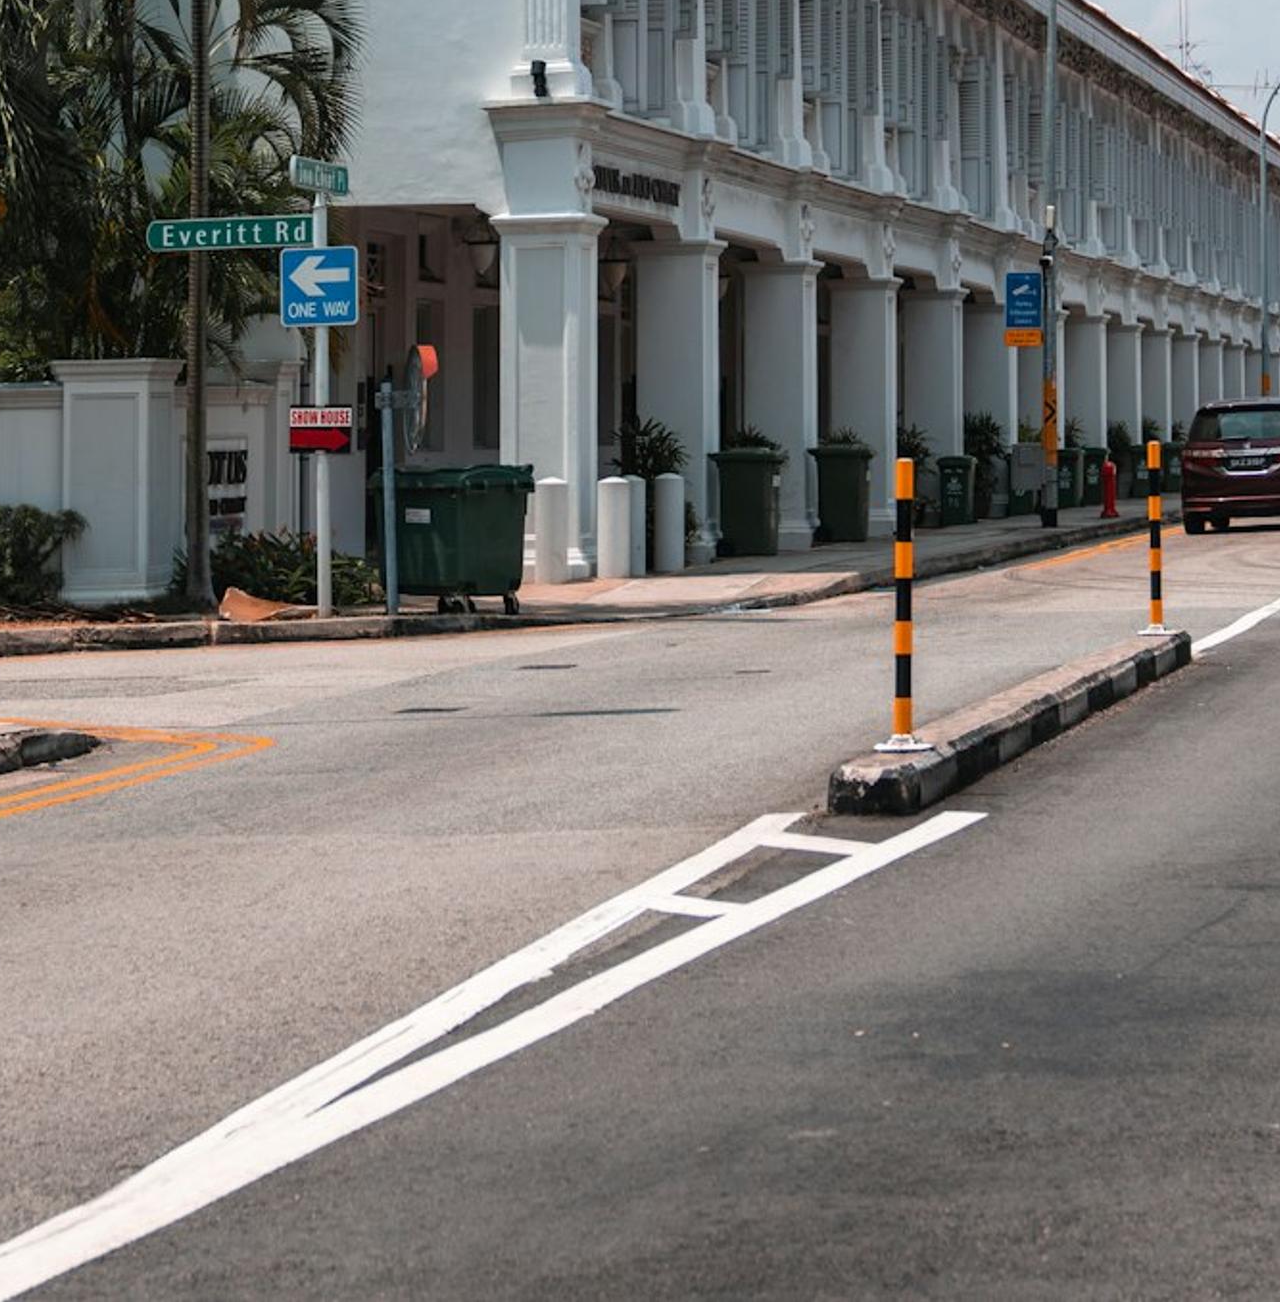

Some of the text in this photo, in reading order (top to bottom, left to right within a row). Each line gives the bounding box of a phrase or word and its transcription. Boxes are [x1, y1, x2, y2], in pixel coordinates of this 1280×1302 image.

[162, 220, 307, 247] Everitt Rd
[288, 300, 350, 319] ONE WAY
[292, 410, 349, 424] SHOW HOUSE
